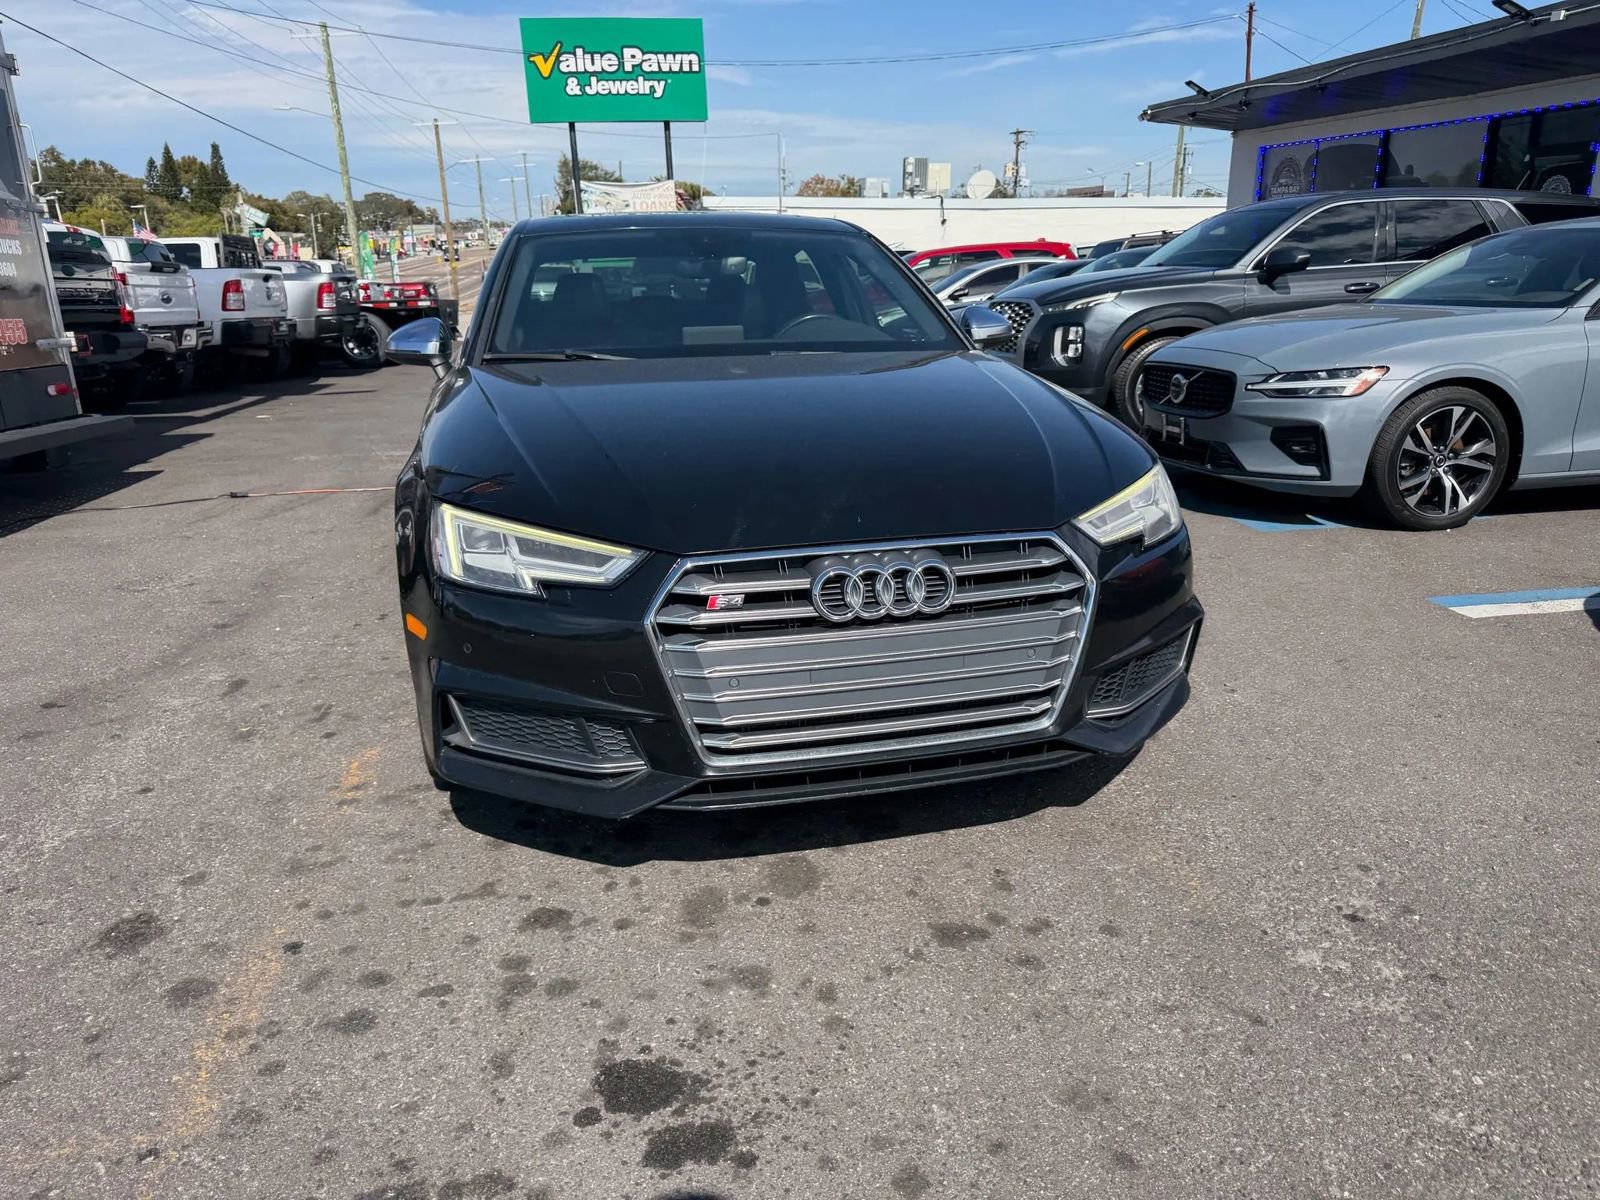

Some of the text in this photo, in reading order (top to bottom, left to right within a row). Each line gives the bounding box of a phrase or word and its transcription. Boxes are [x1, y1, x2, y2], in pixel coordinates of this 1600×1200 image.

[529, 41, 701, 79] Value Pawn
[565, 75, 666, 98] & Jewelry
[632, 199, 675, 211] LOANS
[715, 597, 742, 607] S4
